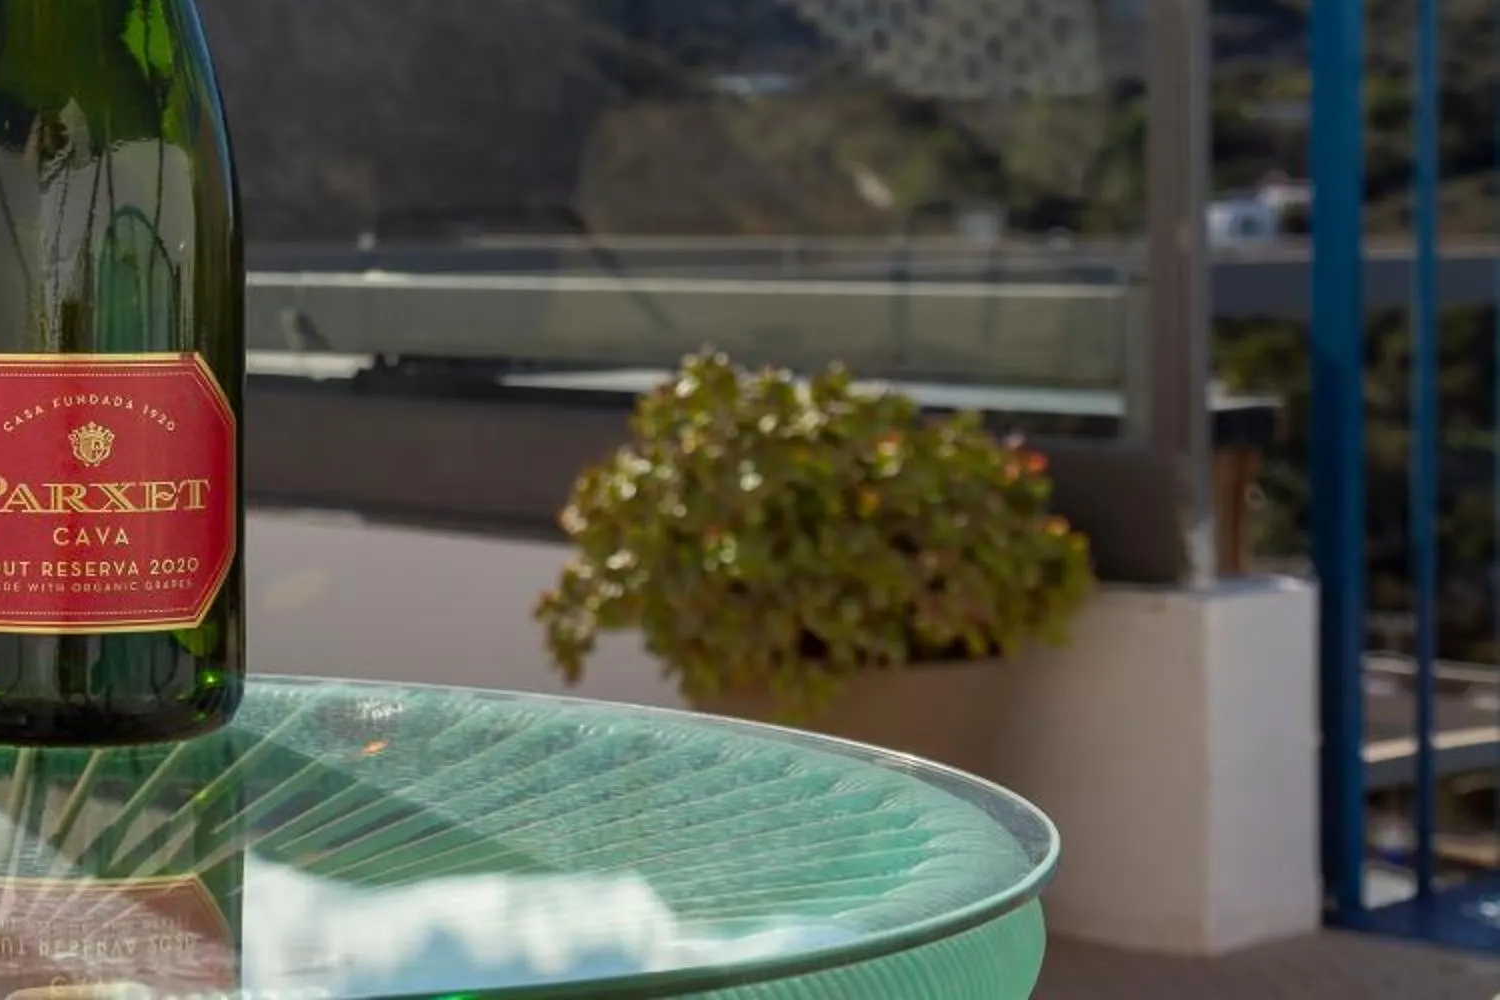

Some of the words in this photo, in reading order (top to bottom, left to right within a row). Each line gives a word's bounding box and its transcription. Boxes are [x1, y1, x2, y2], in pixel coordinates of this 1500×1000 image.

[2, 405, 45, 433] CASA
[53, 393, 134, 411] FUNDADA
[142, 404, 176, 433] 1920
[53, 527, 131, 547] CAVA
[41, 559, 140, 578] RESERVA
[149, 556, 199, 575] 2020
[28, 580, 65, 594] WITH
[71, 580, 139, 594] ORGANIC
